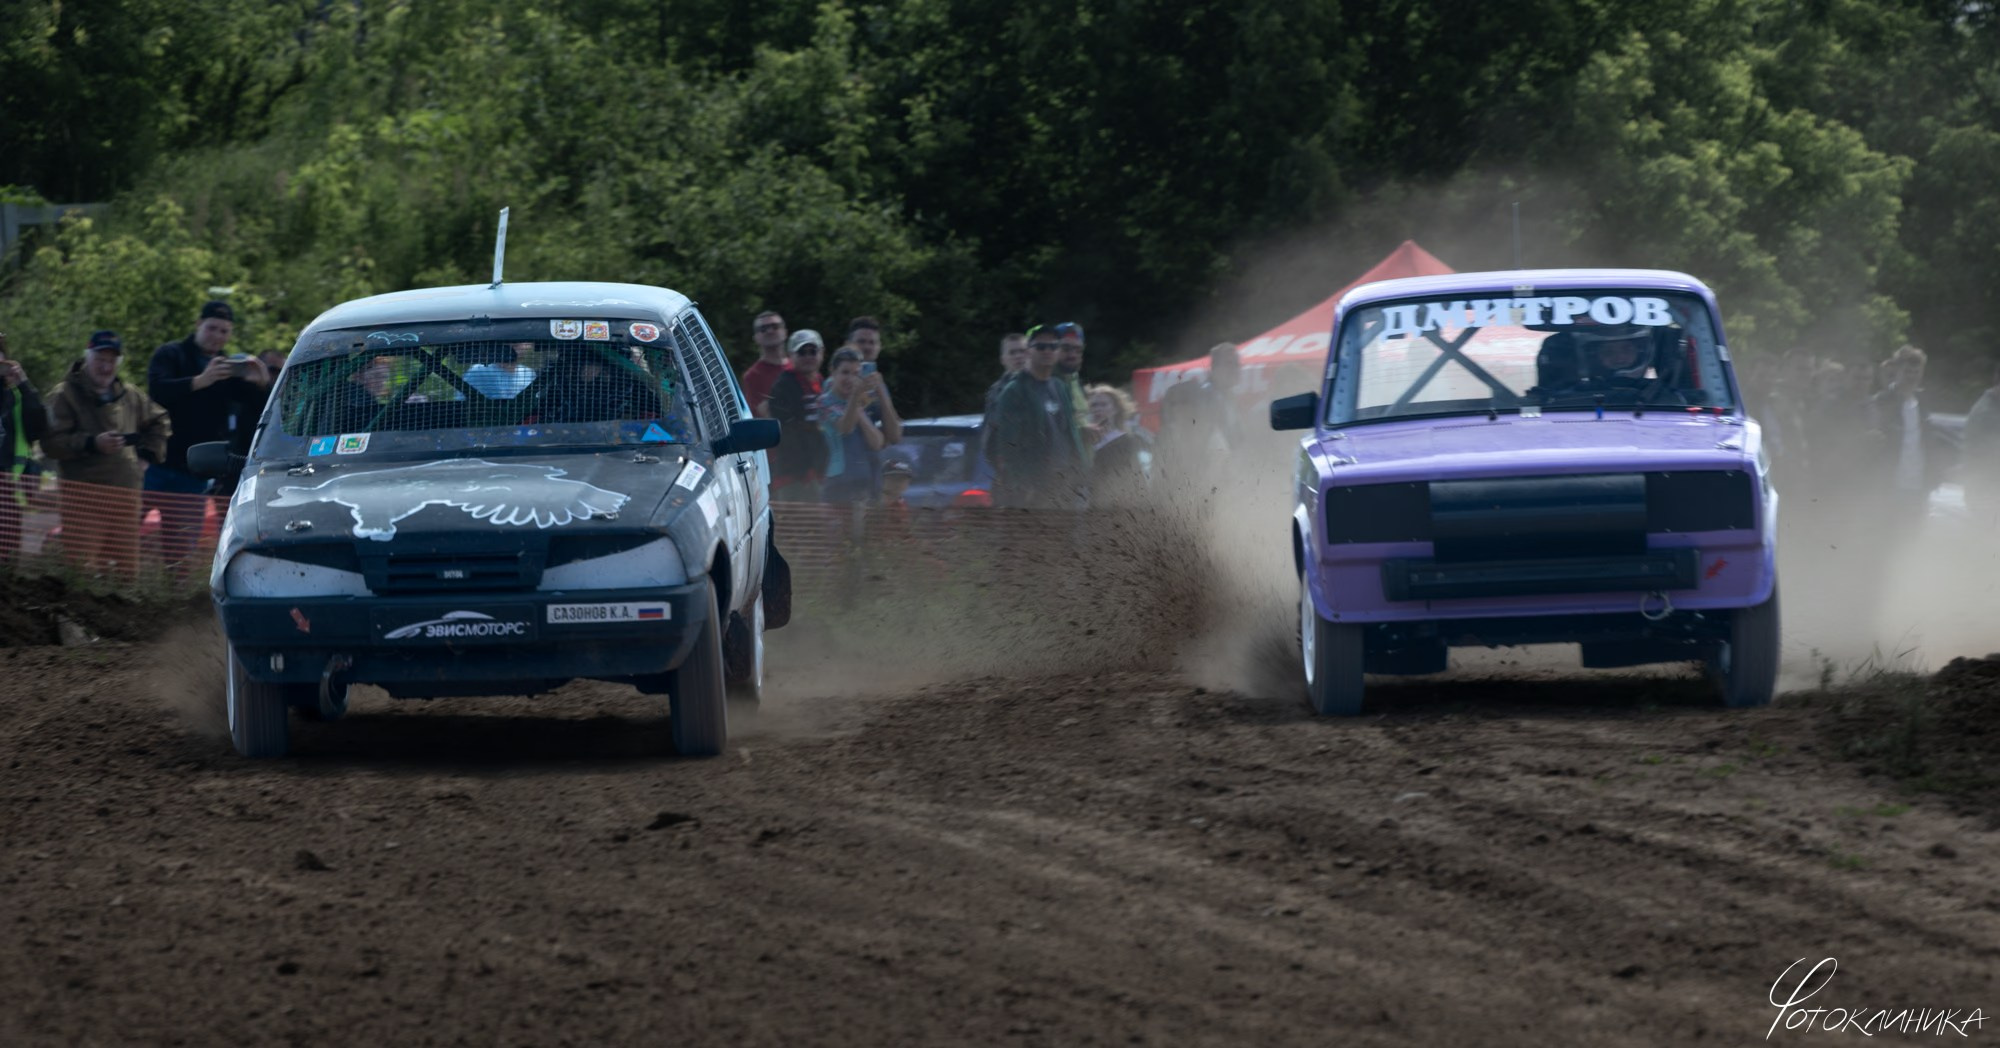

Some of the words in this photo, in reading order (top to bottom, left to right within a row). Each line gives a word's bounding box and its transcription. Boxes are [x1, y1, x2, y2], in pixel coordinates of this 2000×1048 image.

[1381, 296, 1673, 341] ДМИТРОВ
[553, 605, 607, 620] САЗОНОВ
[609, 604, 634, 619] К.А.
[425, 621, 525, 638] ЭВИСМОТОРС
